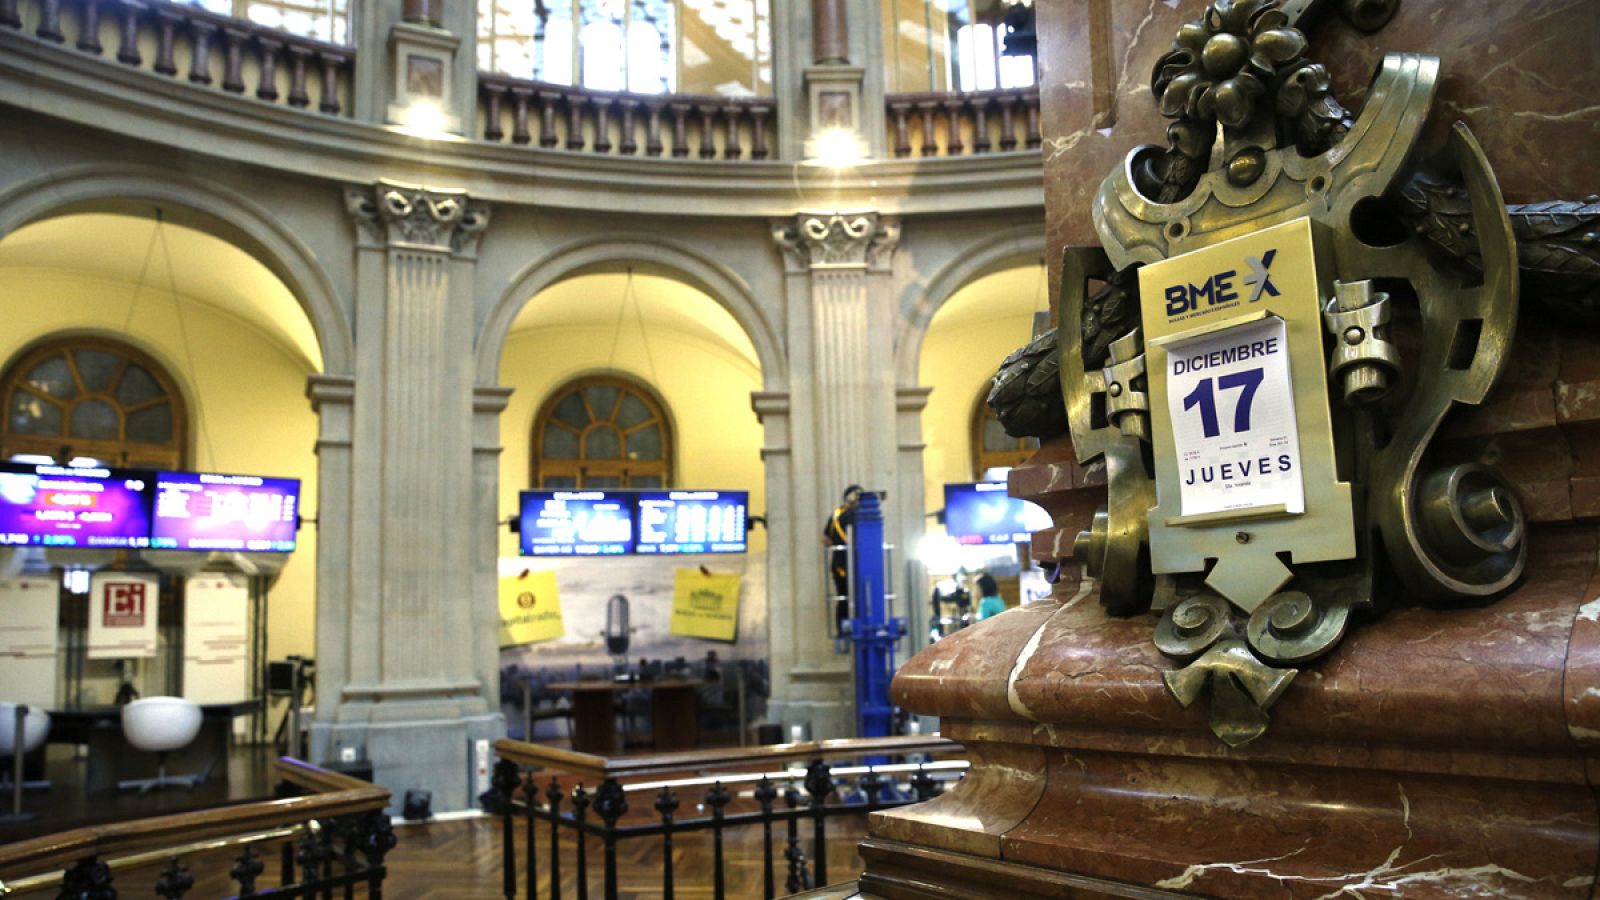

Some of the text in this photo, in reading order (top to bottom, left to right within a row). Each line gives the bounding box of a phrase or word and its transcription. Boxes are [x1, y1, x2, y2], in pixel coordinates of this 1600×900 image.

[1165, 270, 1238, 316] BME
[1174, 337, 1278, 376] DICIEMBRE
[1183, 367, 1264, 438] 17
[1186, 455, 1292, 485] JUEVES
[107, 585, 142, 616] Ei
